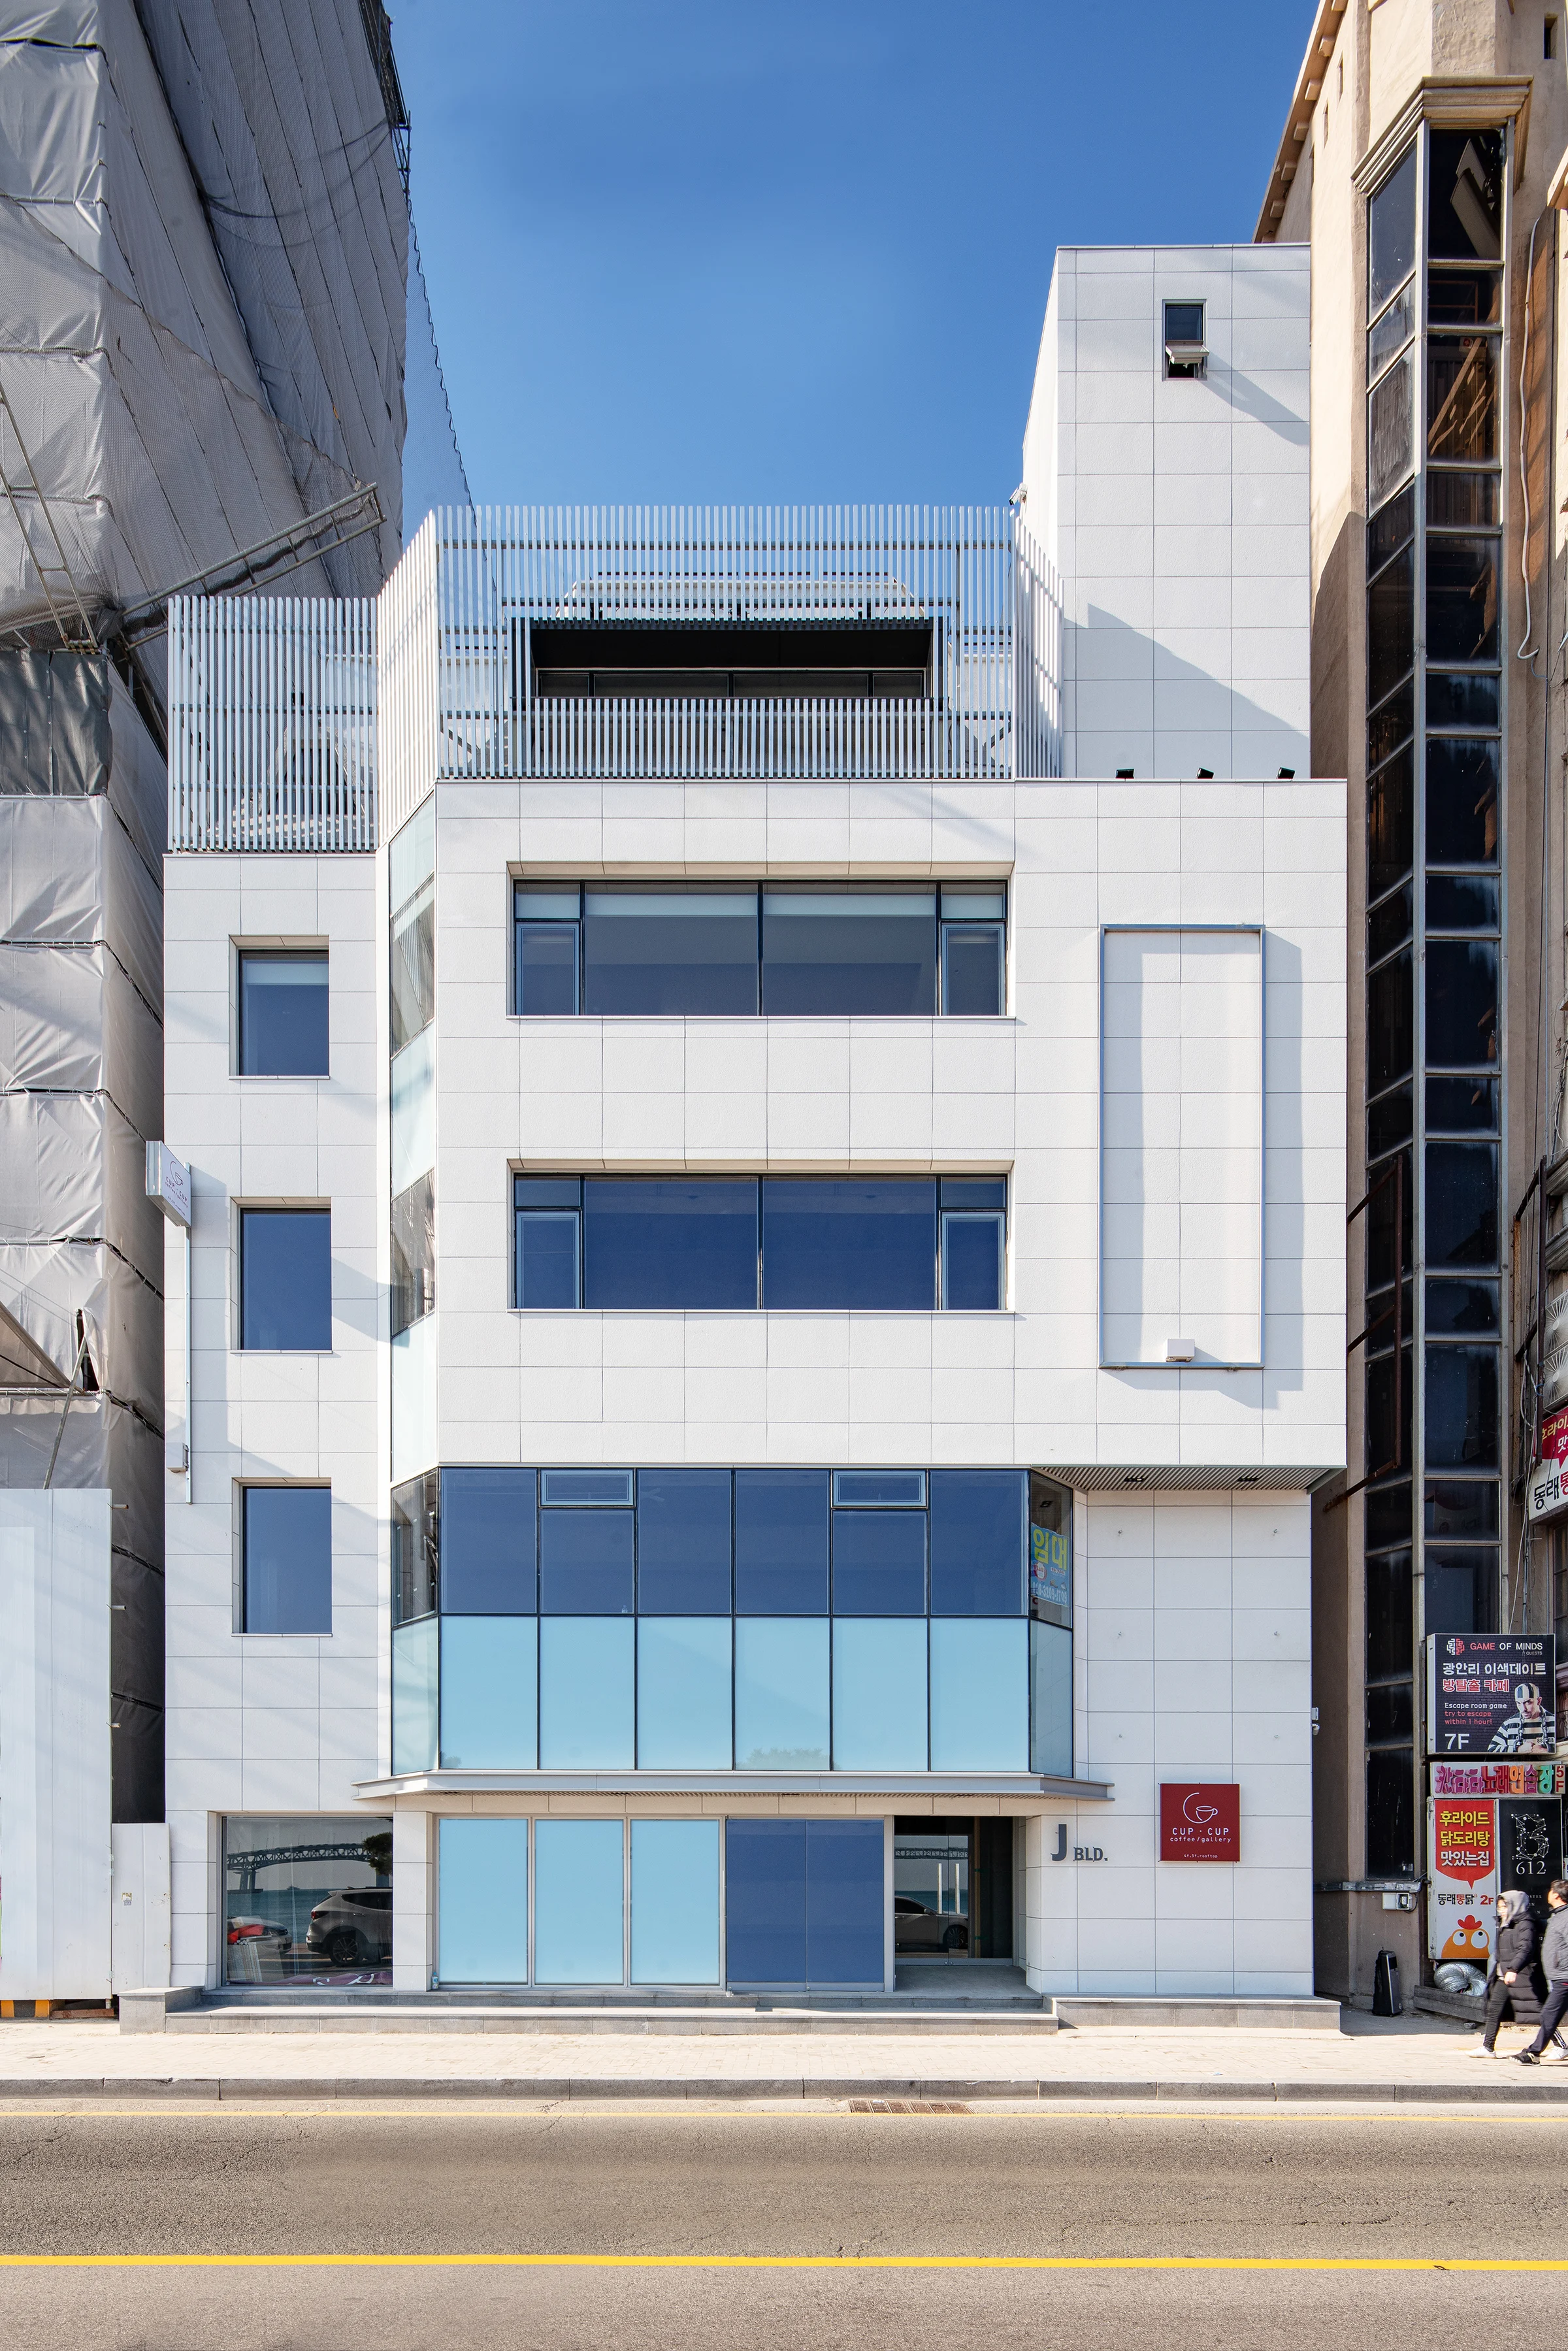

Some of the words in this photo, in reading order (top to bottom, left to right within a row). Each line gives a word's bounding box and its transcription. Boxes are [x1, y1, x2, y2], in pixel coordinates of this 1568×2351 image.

[1033, 1528, 1068, 1570] 임대
[1443, 1662, 1480, 1675] 광안리
[1484, 1662, 1546, 1675] 이색데이트
[1443, 1679, 1480, 1692] 방탈출
[1484, 1679, 1509, 1692] 카페
[1445, 1734, 1469, 1749] 7F
[1439, 1811, 1490, 1827] 후라이드
[1051, 1824, 1067, 1862] J
[1073, 1847, 1108, 1862] BLD.
[1440, 1831, 1490, 1847] 닭도리탕
[1441, 1850, 1490, 1867] 맛있는집
[1516, 1861, 1547, 1875] 612
[1480, 1894, 1494, 1905] 2F
